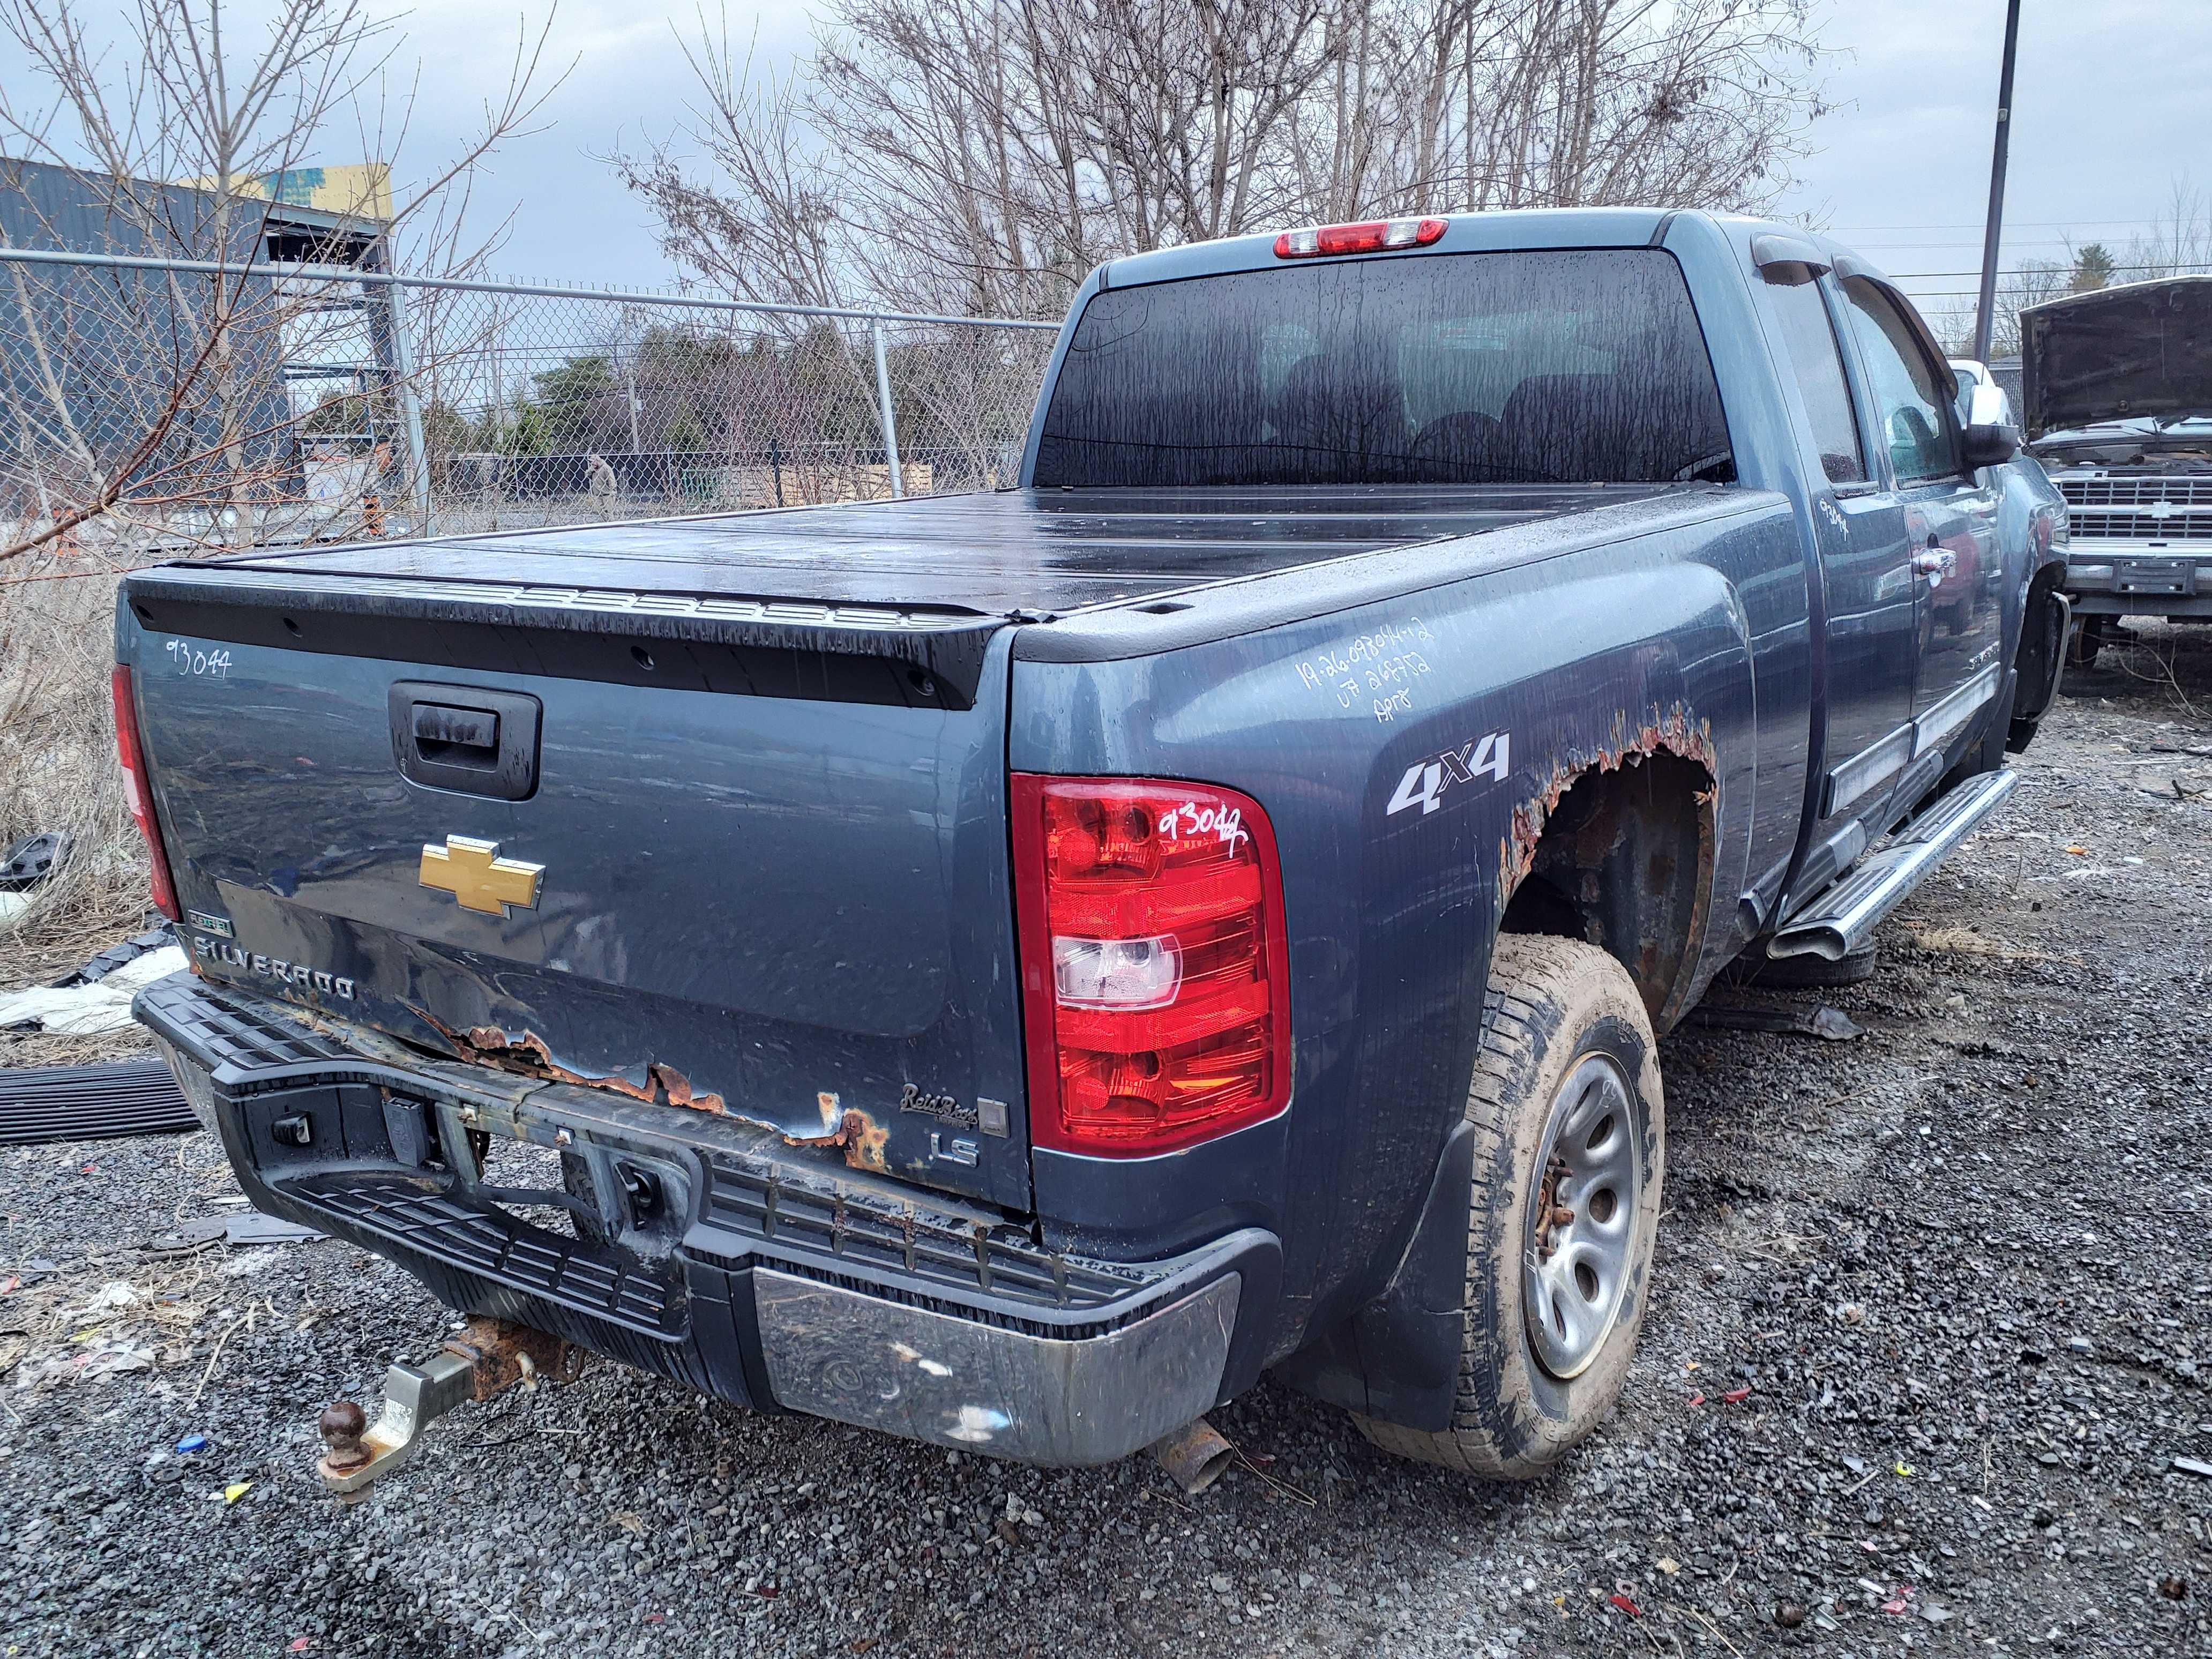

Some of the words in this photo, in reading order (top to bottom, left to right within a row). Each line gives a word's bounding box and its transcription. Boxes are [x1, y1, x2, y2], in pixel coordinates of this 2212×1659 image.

[166, 639, 232, 681] 93044
[1159, 802, 1249, 858] 93044
[194, 936, 356, 1001] SILVERADO
[930, 1132, 978, 1168] LS
